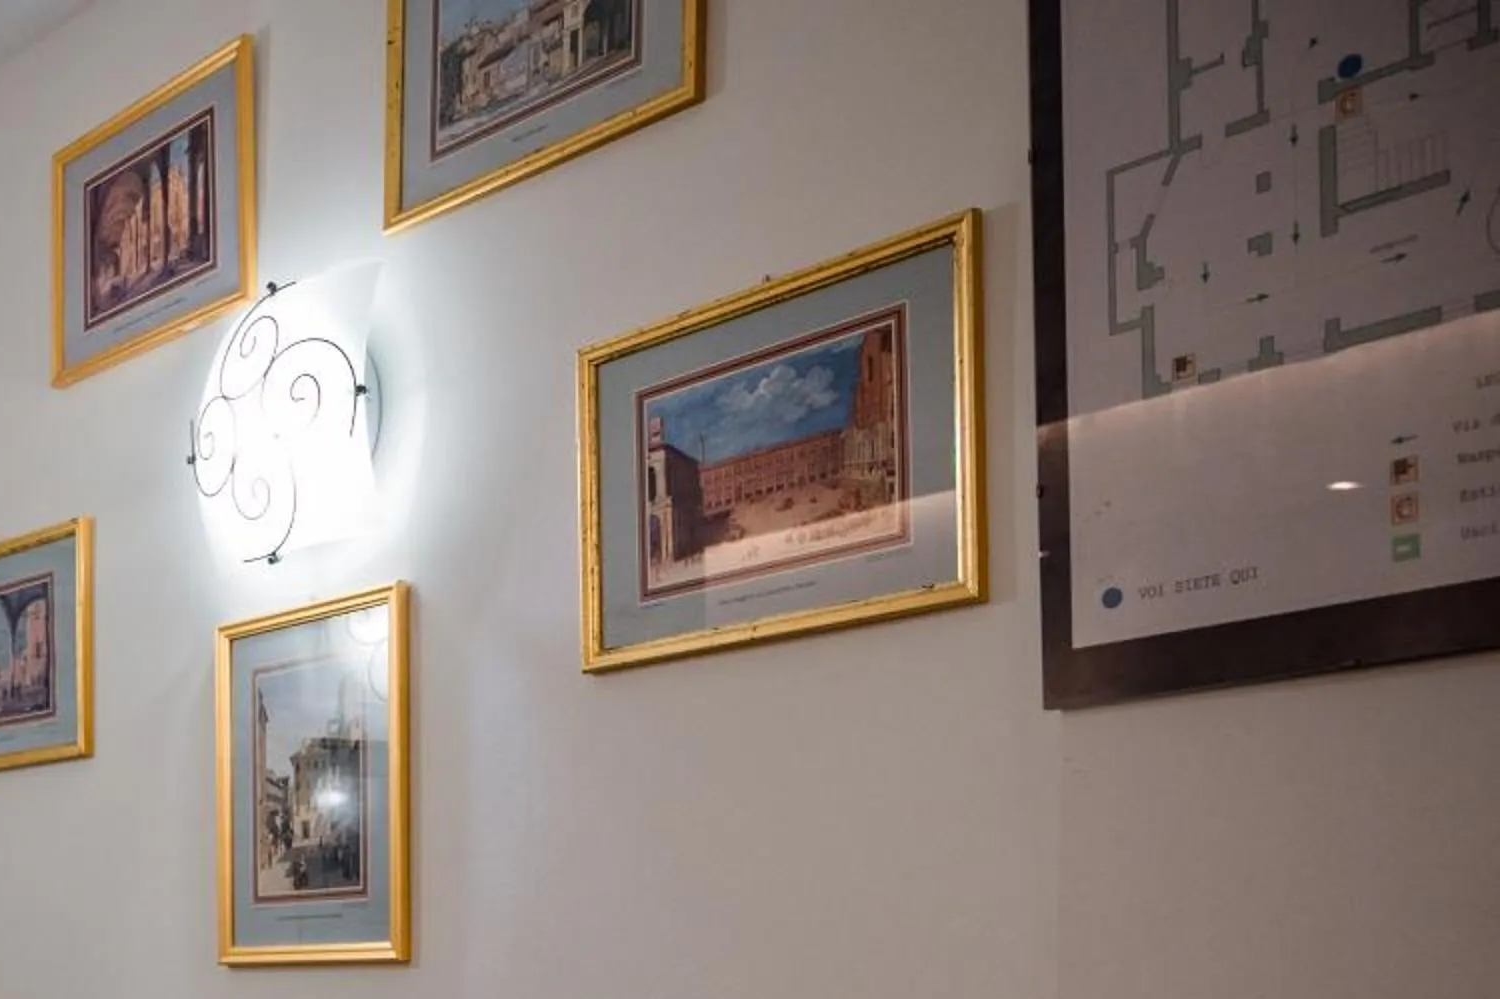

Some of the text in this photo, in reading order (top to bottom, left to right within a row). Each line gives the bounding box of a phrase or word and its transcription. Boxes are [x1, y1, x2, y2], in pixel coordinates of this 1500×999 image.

[1138, 566, 1259, 600] VOI SIETE QUI
